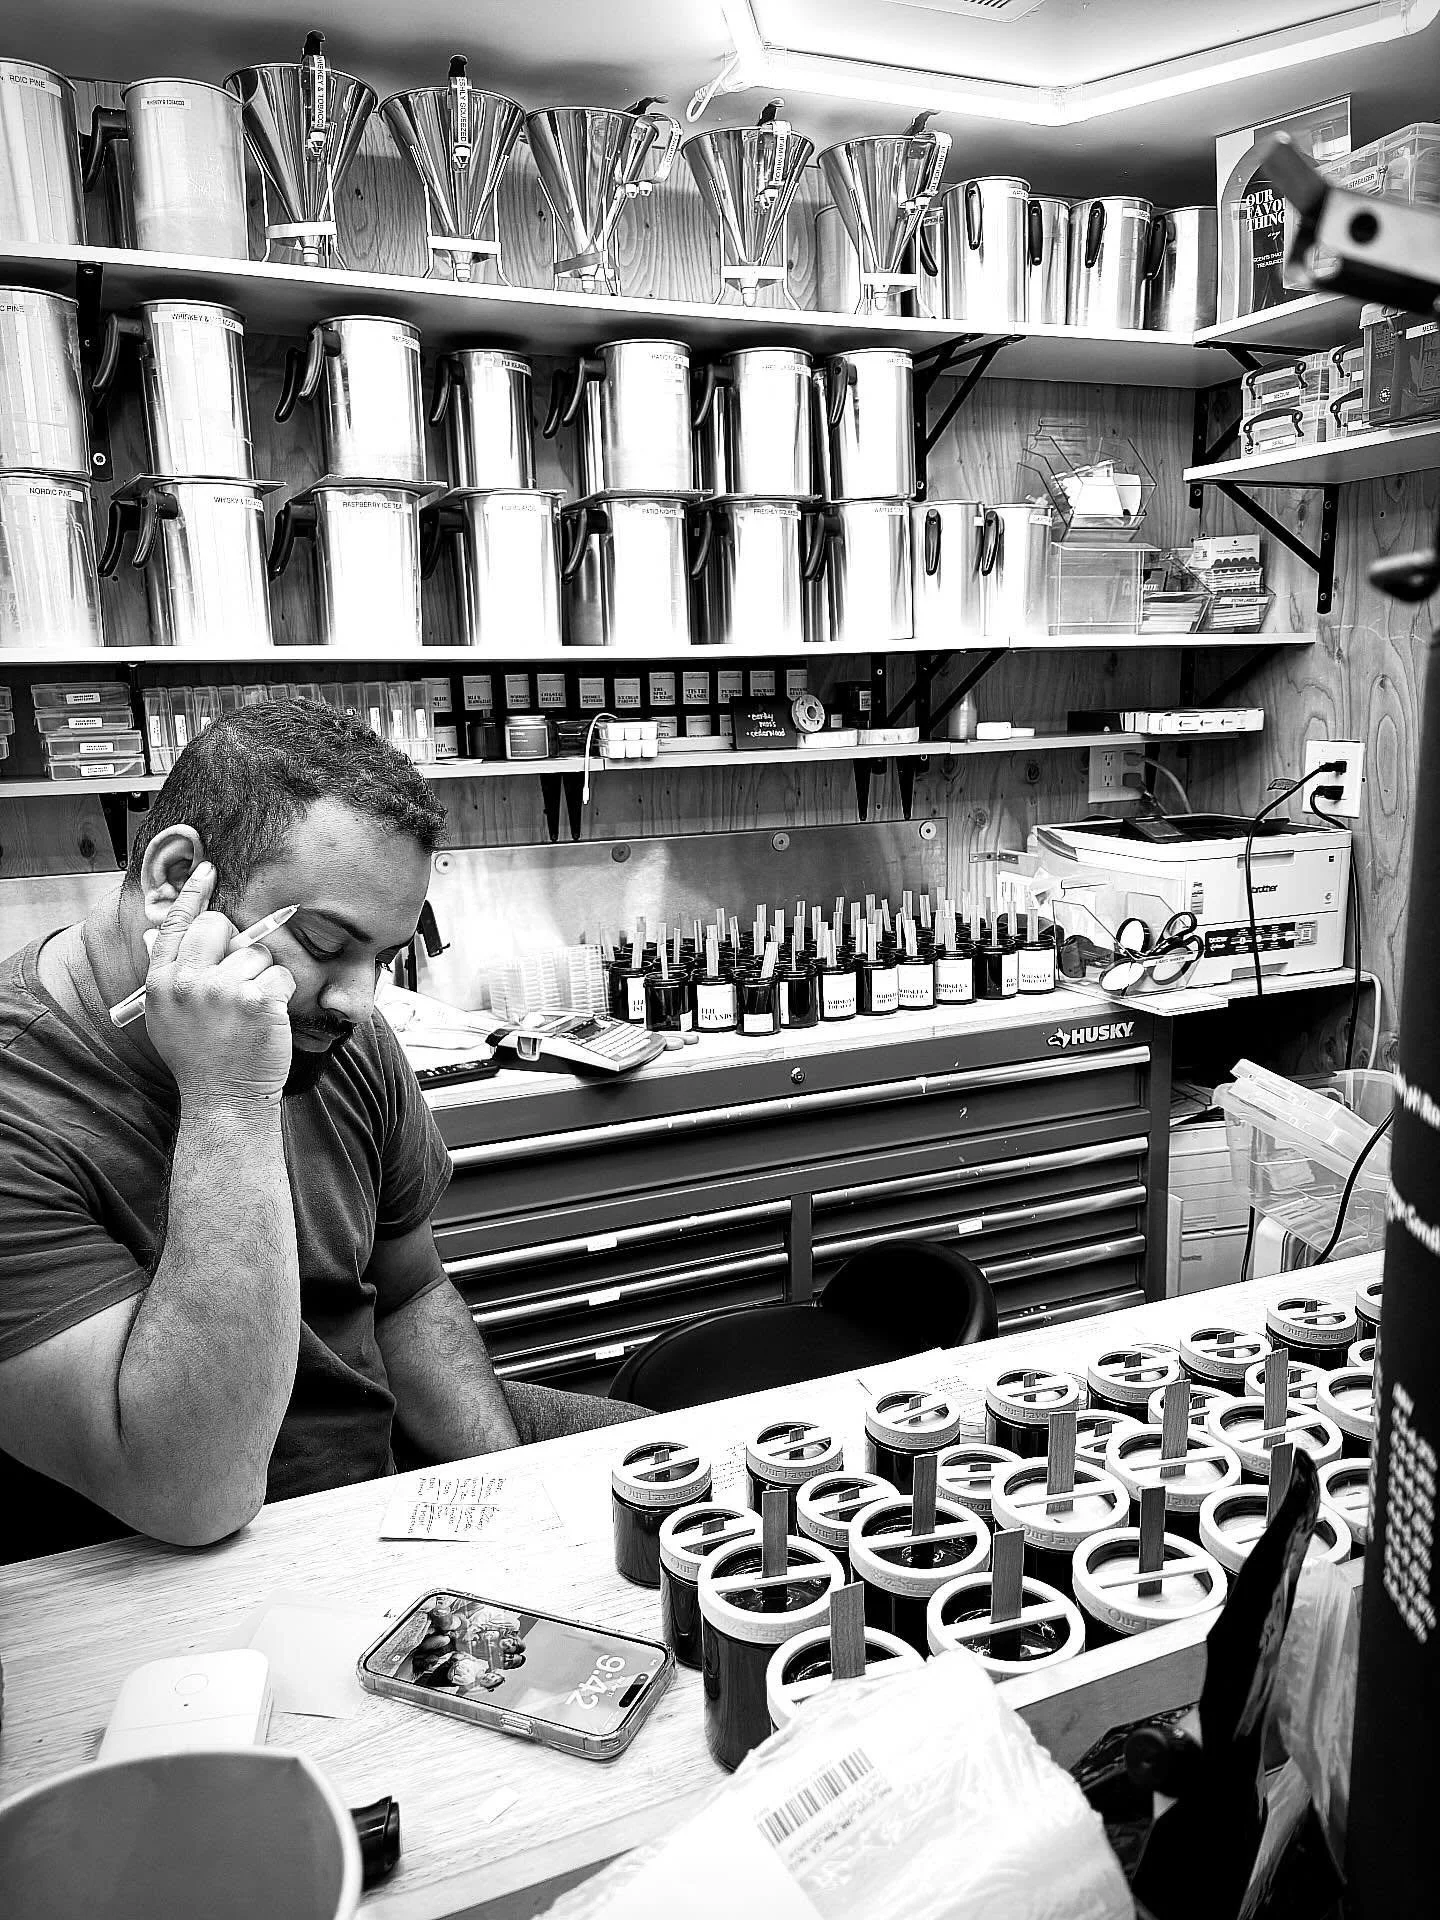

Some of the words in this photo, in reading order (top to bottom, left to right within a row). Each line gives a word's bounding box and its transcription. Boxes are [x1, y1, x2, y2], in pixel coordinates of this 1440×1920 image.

[1245, 188, 1275, 208] OUR
[29, 487, 58, 499] NORDIC
[342, 500, 381, 510] RASPBERRY
[753, 508, 778, 517] FRESHLY
[701, 1013, 733, 1021] ISLANDS
[1071, 1021, 1135, 1045] HUSKY
[759, 1462, 782, 1478] Our
[623, 1484, 645, 1500] Our
[808, 1521, 831, 1540] Our
[1022, 1523, 1046, 1542] Our
[669, 1556, 694, 1576] Our
[1107, 1606, 1140, 1630] Our
[566, 1653, 626, 1711] 9:42
